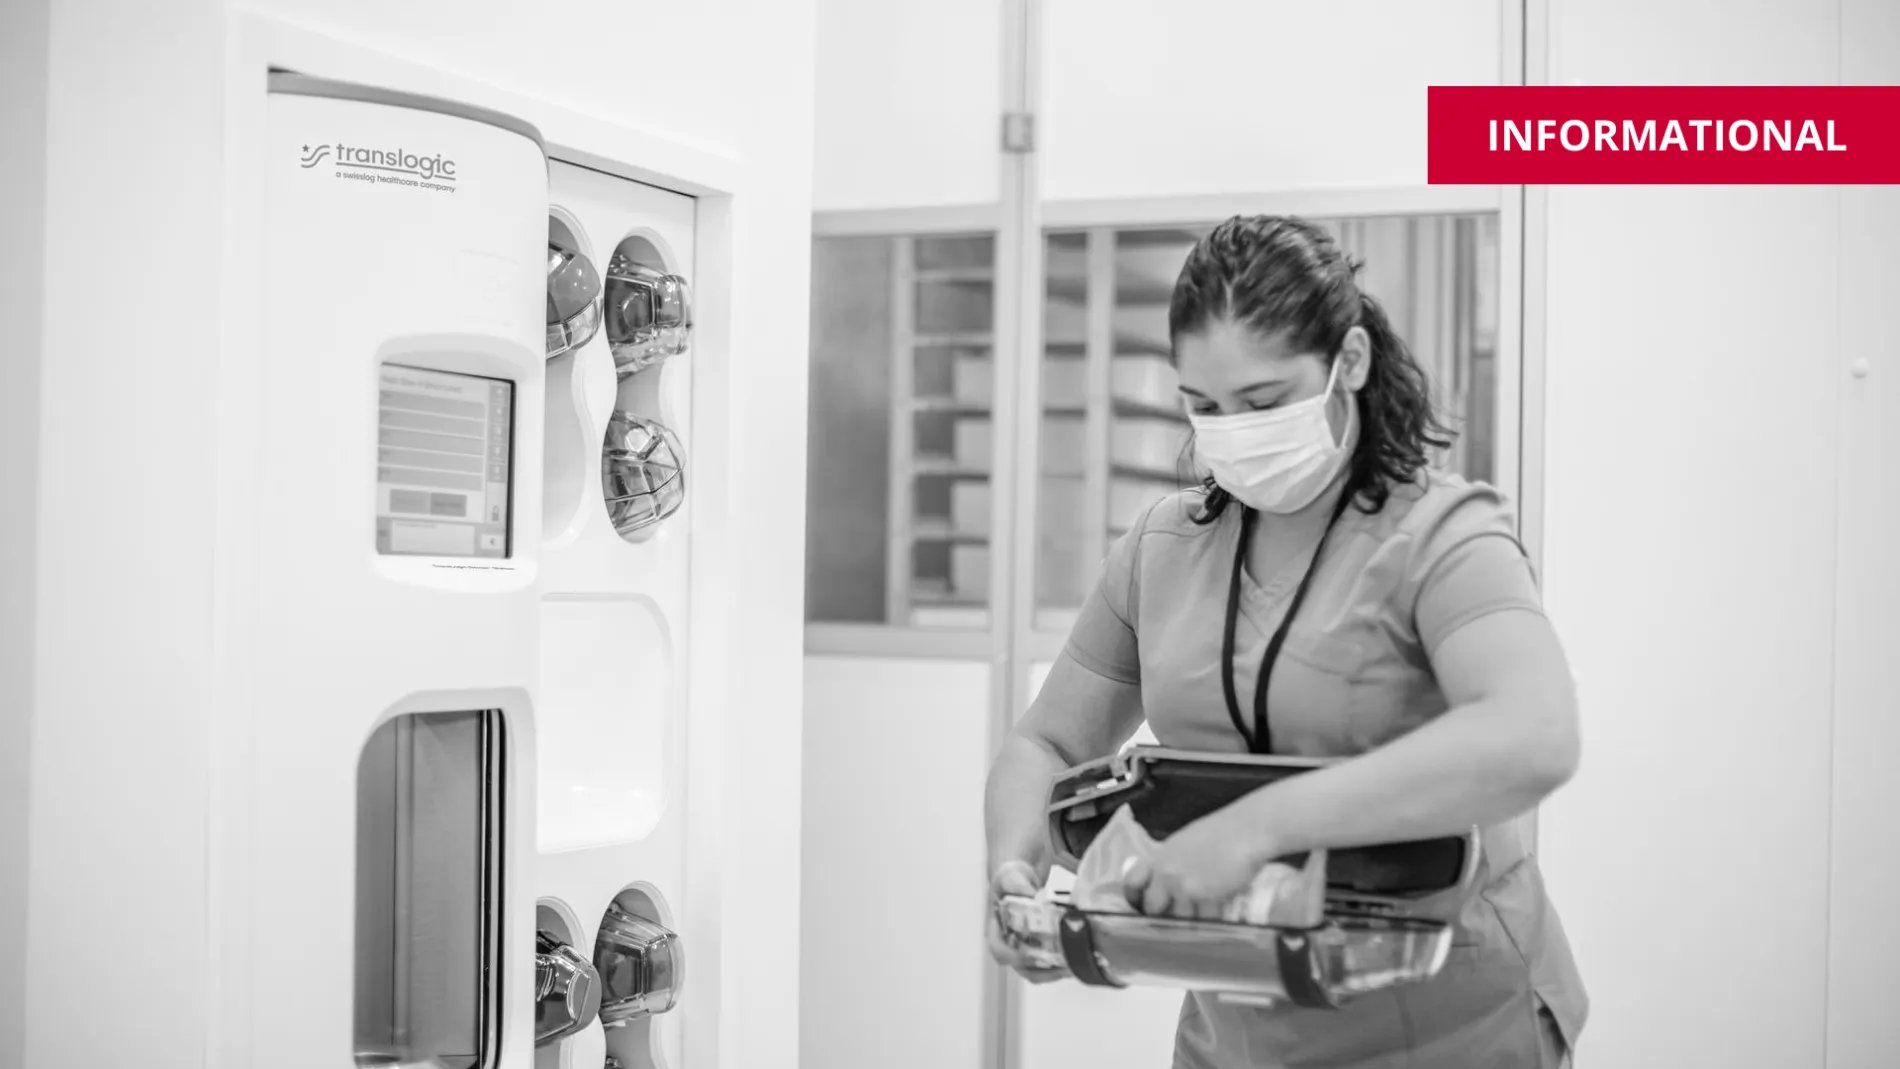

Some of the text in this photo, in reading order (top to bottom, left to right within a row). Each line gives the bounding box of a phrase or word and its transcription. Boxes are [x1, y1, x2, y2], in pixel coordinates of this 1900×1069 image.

[336, 143, 456, 179] translogic
[343, 173, 375, 183] swisslog
[377, 174, 419, 187] healthcare
[420, 182, 456, 193] company
